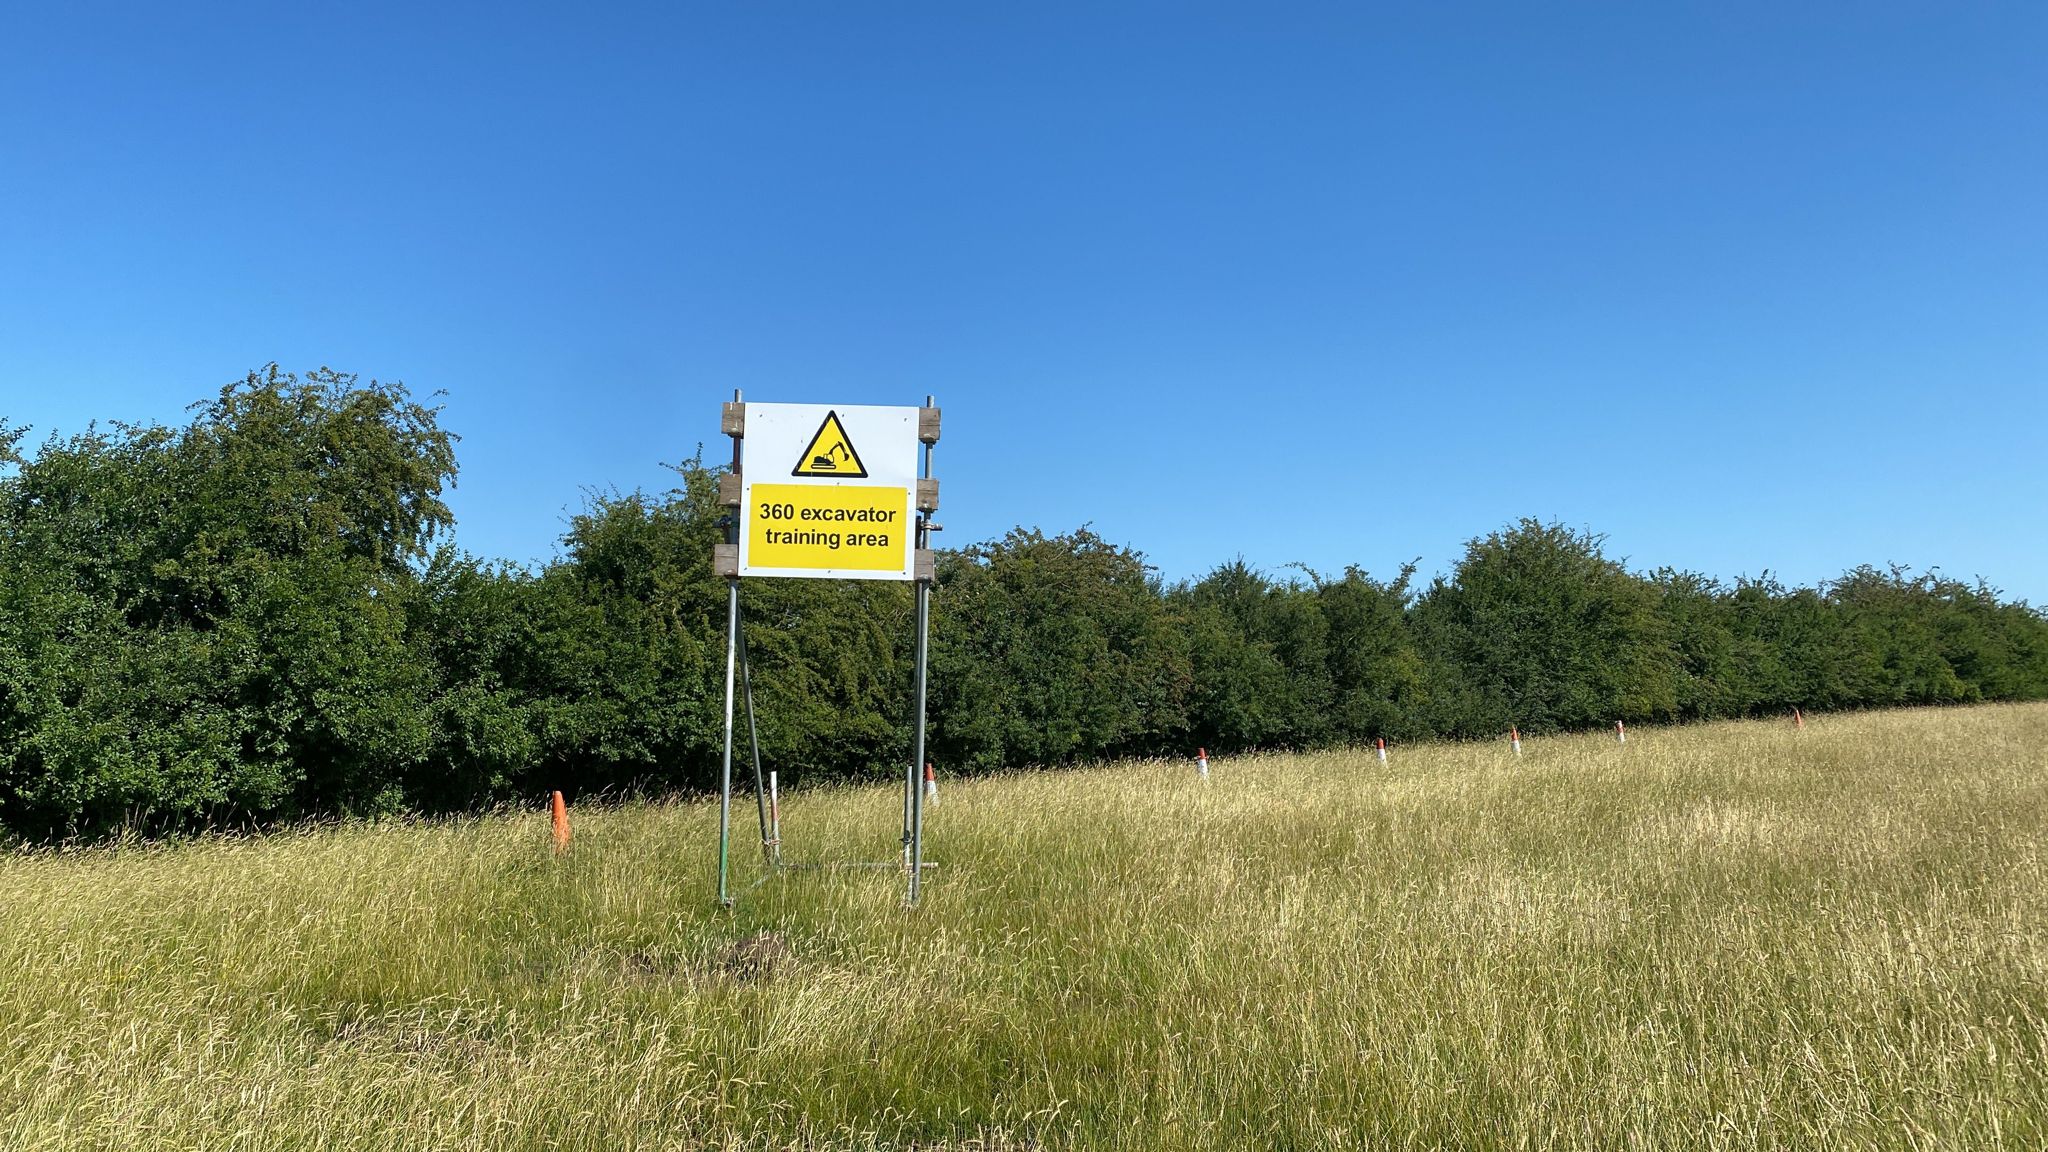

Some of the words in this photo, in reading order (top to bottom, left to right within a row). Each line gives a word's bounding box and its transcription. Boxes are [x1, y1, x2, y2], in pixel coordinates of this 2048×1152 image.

[759, 503, 795, 520] 360
[800, 507, 897, 523] excavator
[765, 528, 841, 550] training
[846, 533, 889, 547] area
